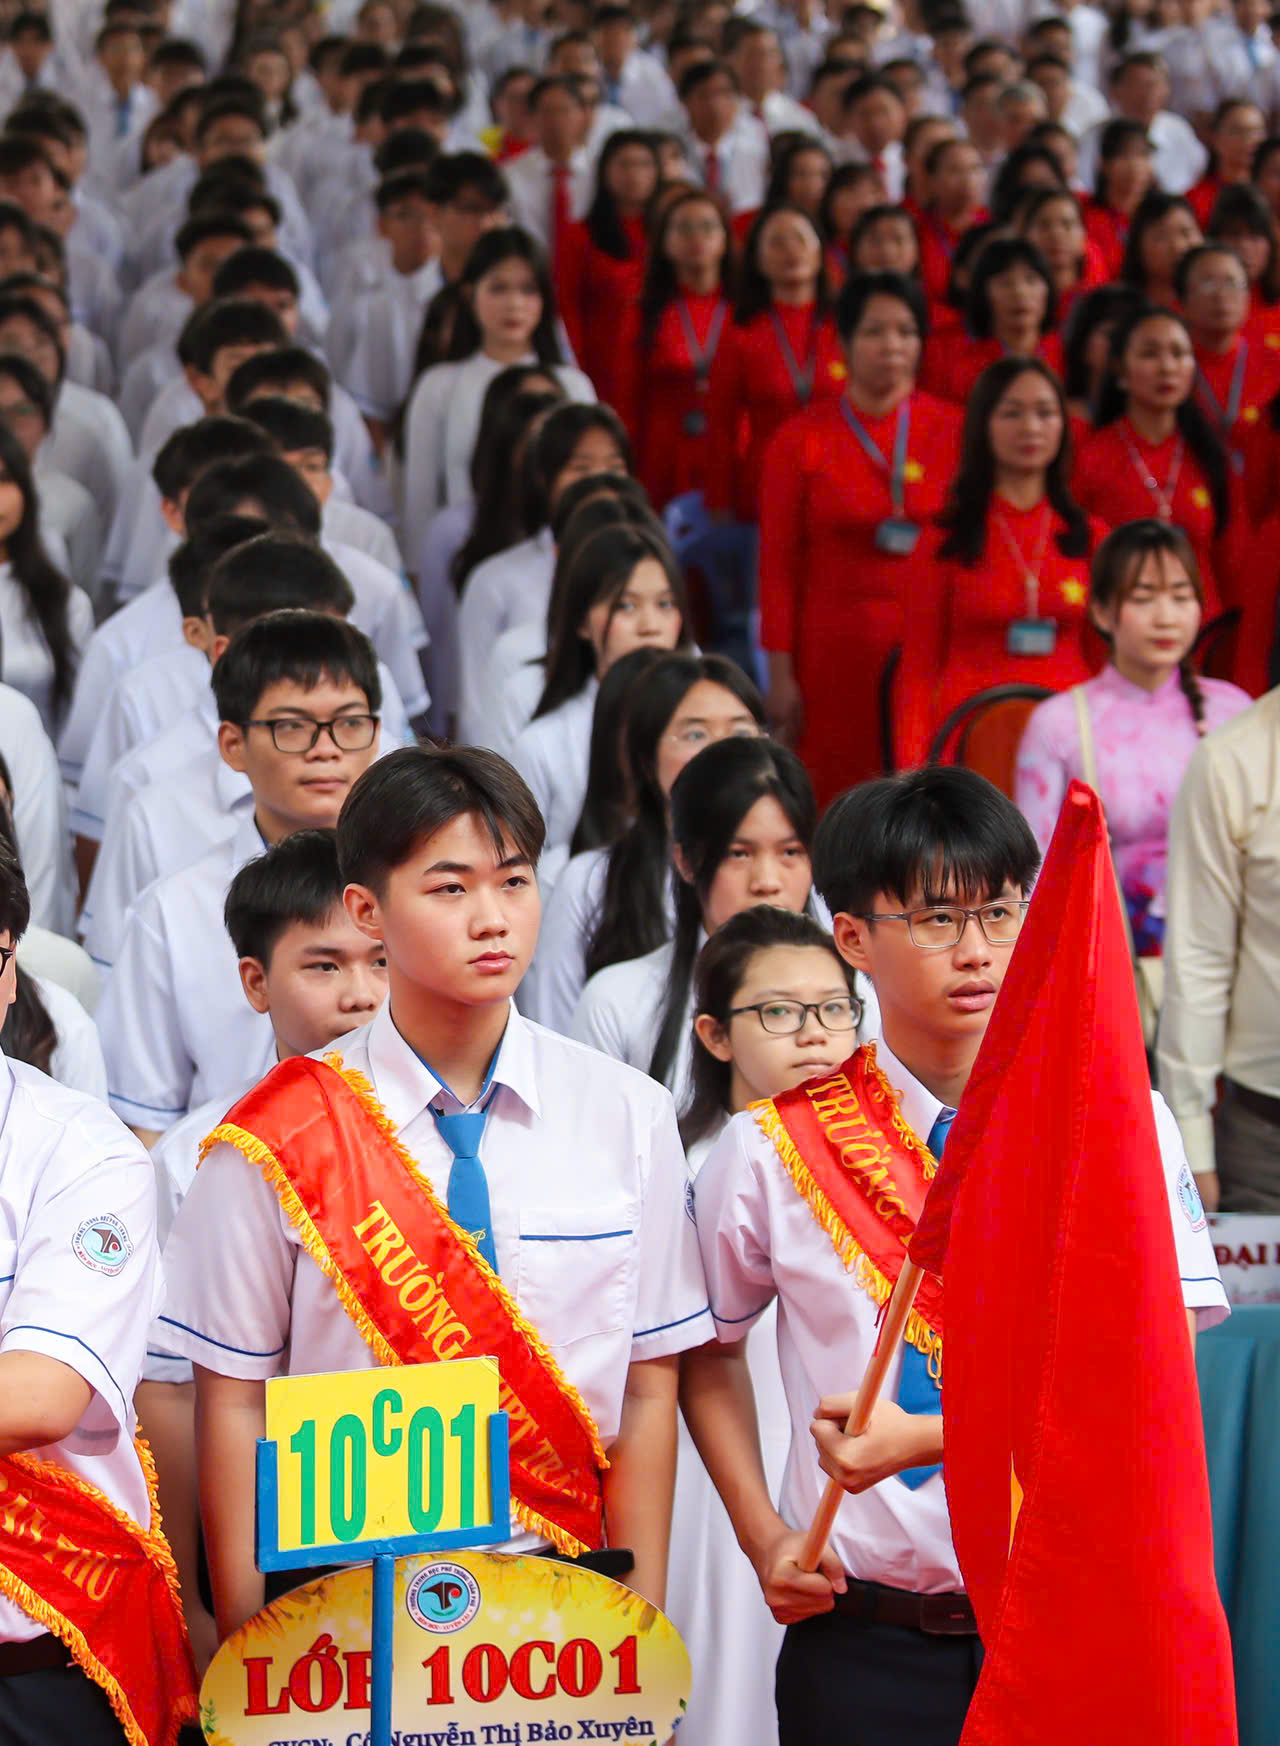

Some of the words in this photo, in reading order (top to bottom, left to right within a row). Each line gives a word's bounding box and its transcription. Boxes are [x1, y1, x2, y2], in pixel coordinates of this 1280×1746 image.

[352, 1200, 472, 1361] TRƯỜNG
[290, 1388, 475, 1545] 10C01
[422, 1635, 642, 1705] 10C01
[391, 1721, 476, 1746] Nguyễn
[481, 1722, 521, 1746] Thị
[527, 1720, 572, 1742] Bảo
[577, 1716, 655, 1742] Xuyên
